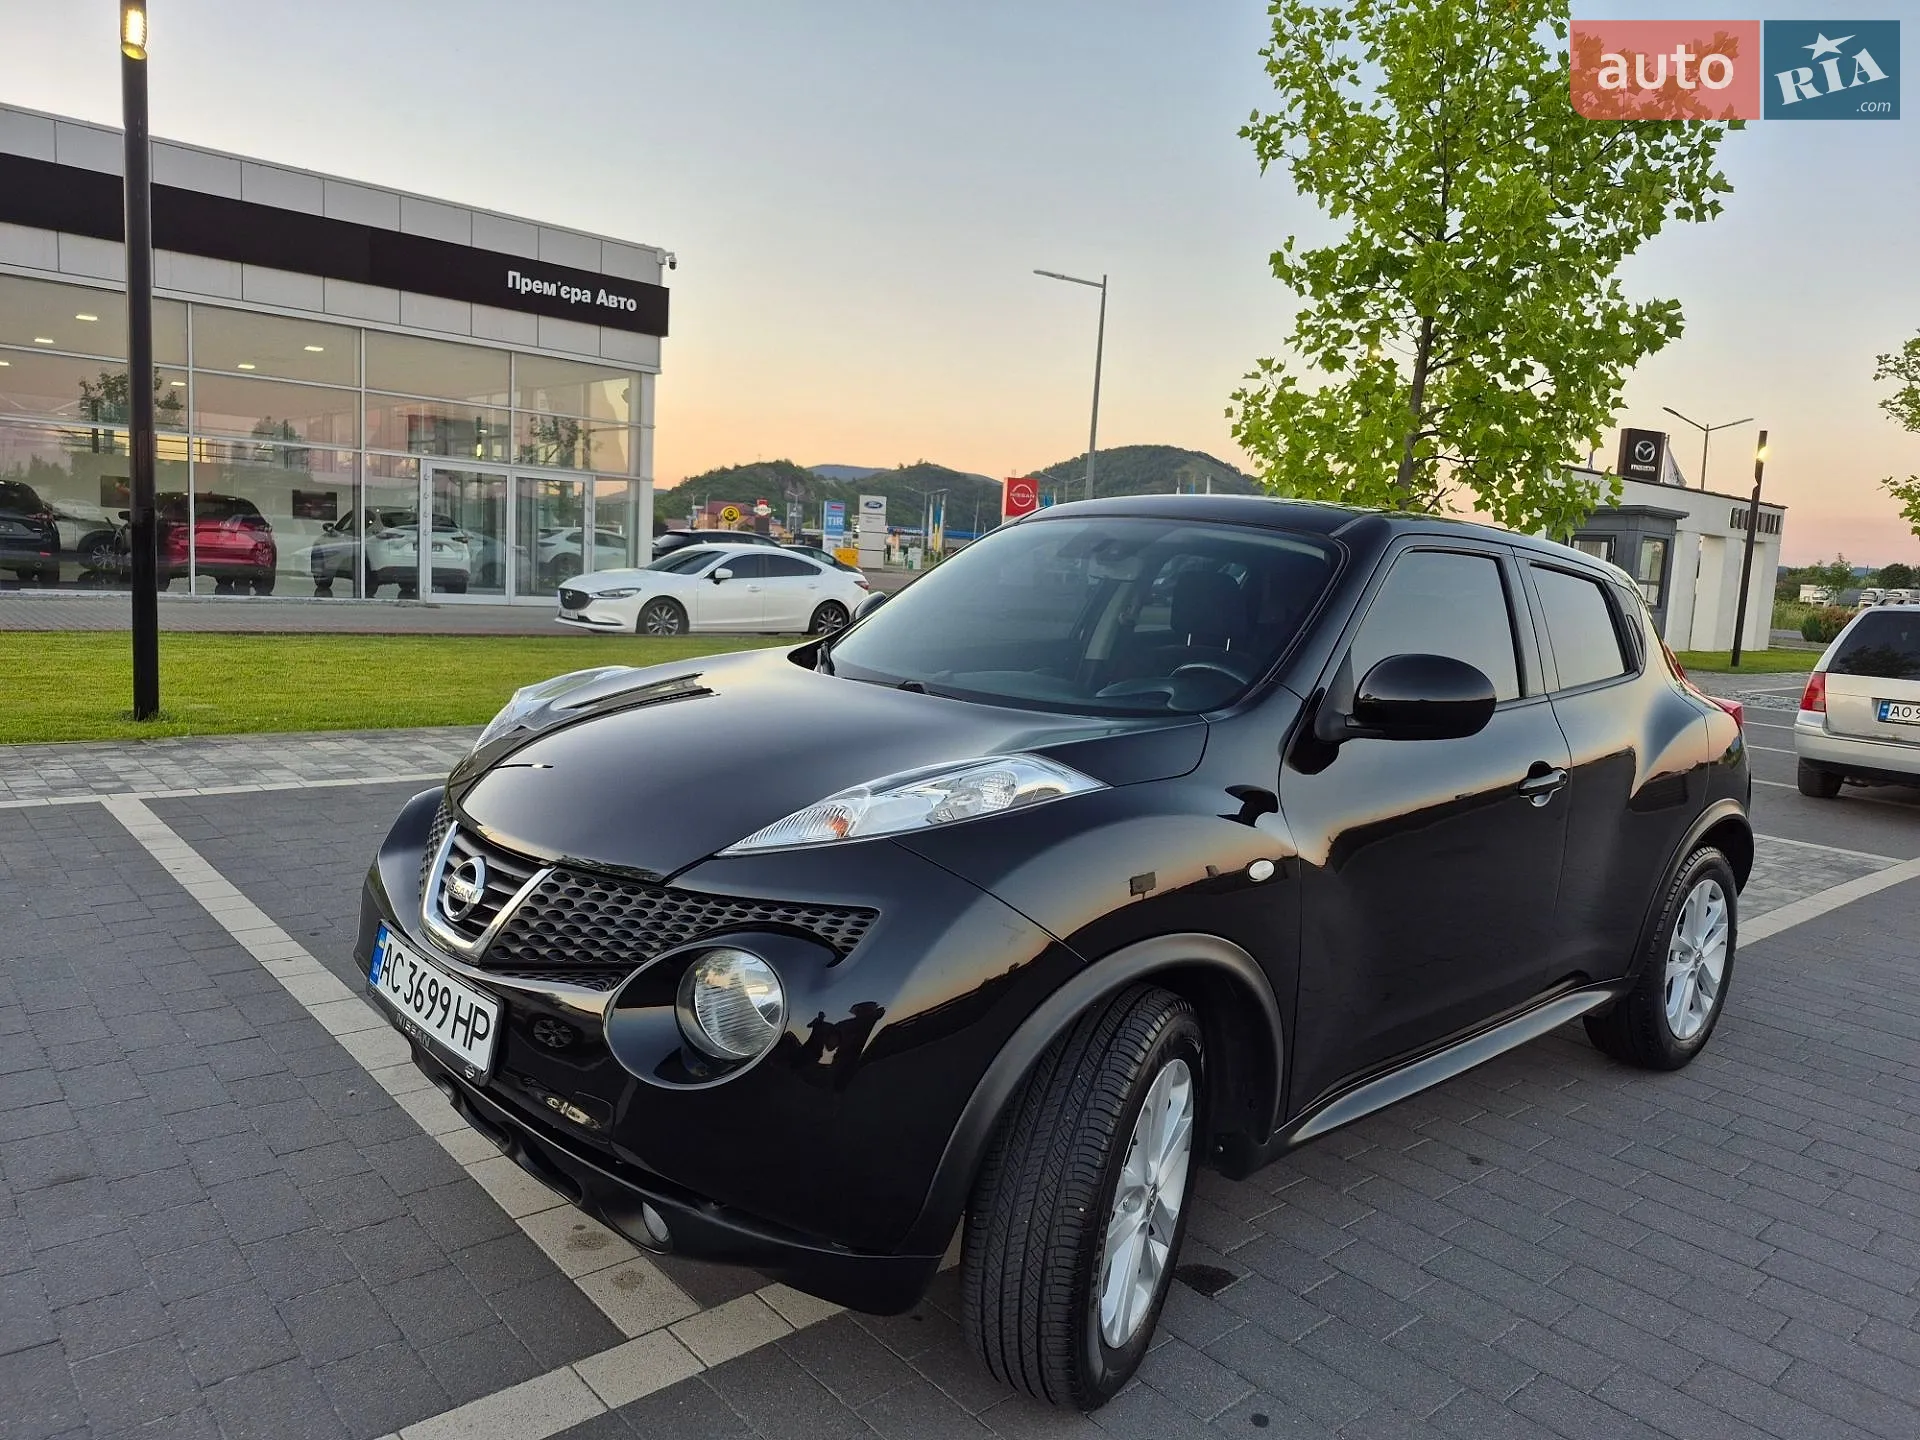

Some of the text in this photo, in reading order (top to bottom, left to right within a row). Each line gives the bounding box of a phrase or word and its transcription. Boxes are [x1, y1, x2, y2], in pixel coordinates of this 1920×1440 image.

[596, 288, 637, 312] Авто
[827, 516, 843, 526] TIR
[1890, 705, 1912, 718] AO
[380, 943, 490, 1051] AC 3699 HP
[396, 1012, 431, 1048] NISSAN
